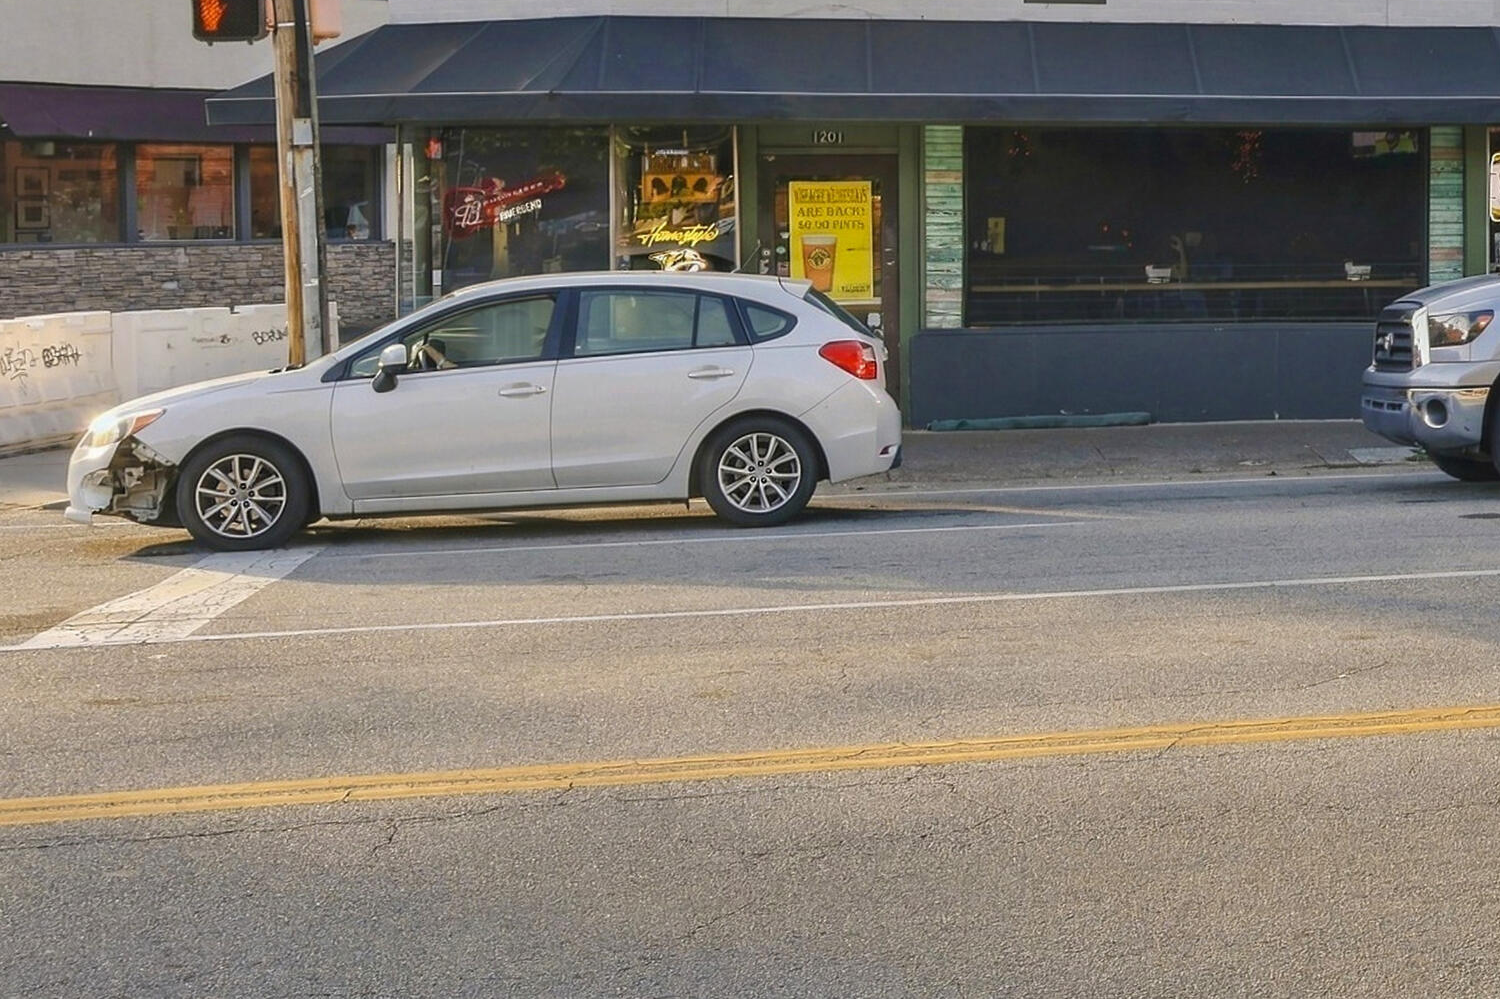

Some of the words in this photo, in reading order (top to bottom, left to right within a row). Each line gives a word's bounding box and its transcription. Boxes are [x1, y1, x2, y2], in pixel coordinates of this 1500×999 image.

[813, 131, 842, 143] 1201
[797, 206, 823, 218] ARE
[833, 219, 865, 230] PINTS
[637, 221, 719, 247] Homestyle
